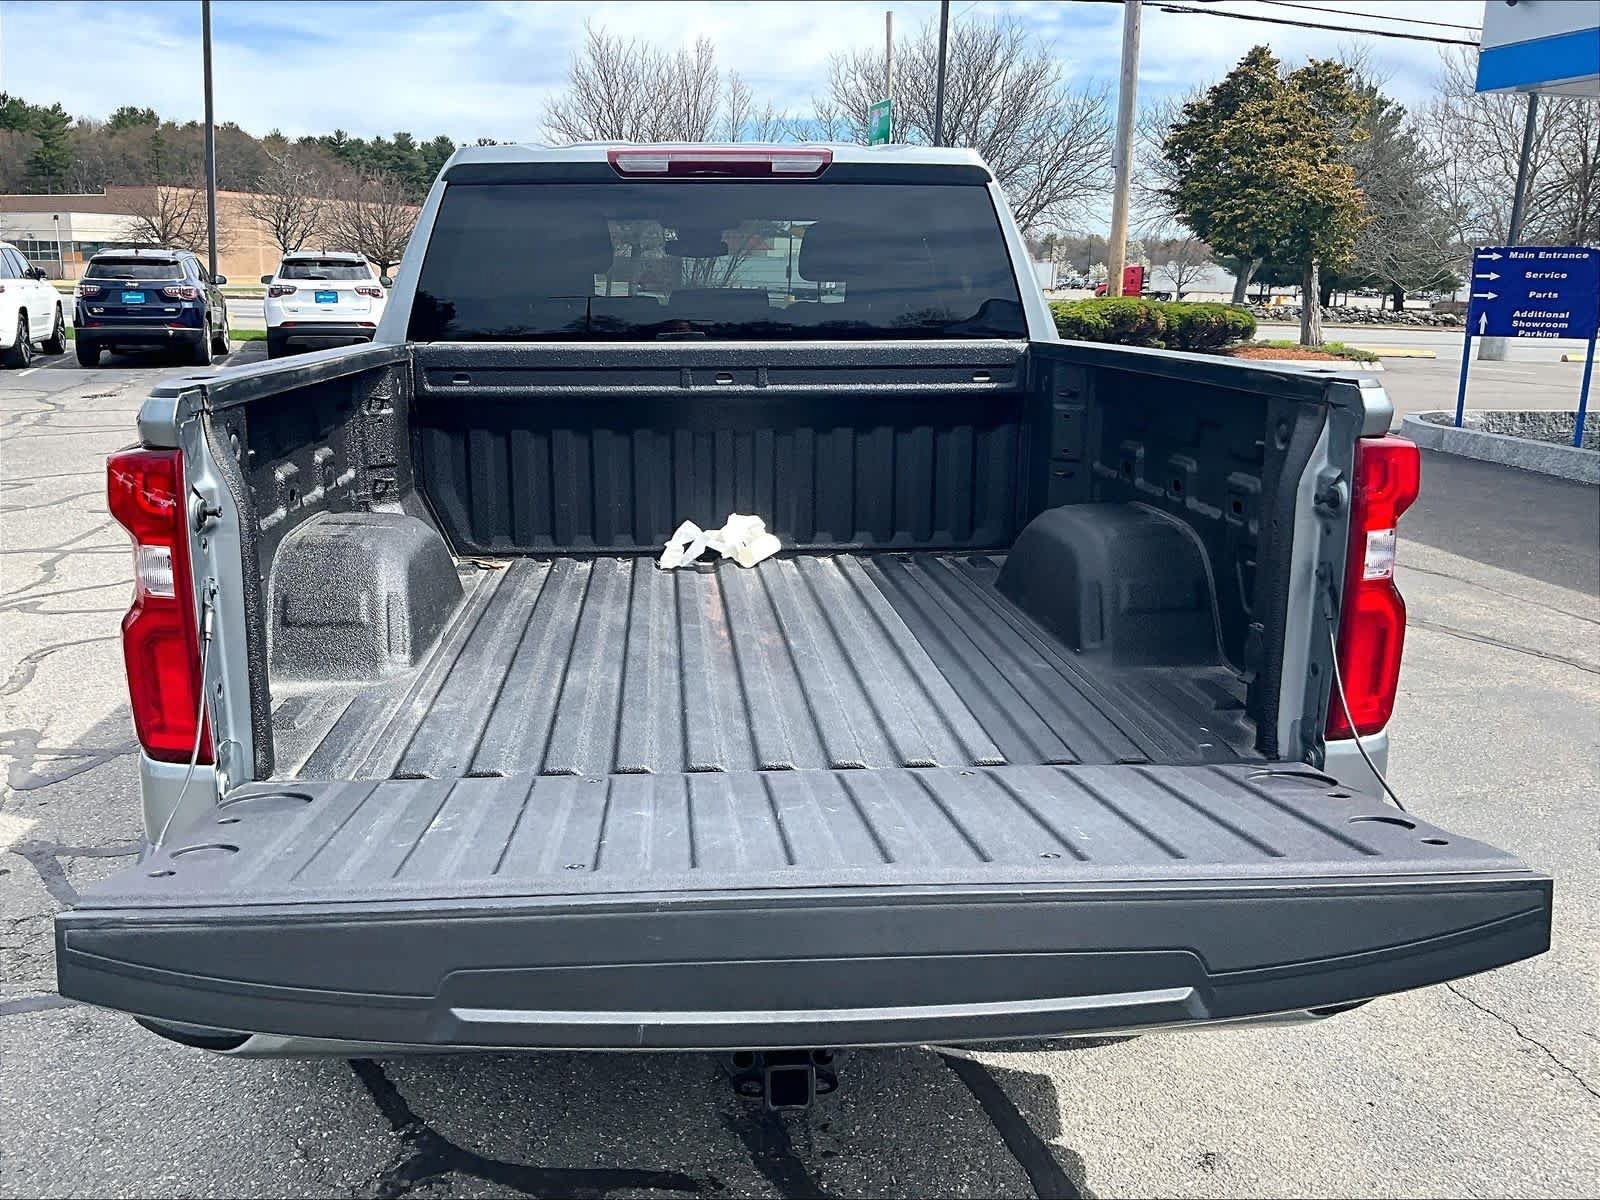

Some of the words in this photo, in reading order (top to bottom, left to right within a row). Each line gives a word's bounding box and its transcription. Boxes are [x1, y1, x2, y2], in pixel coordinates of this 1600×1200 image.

[1508, 251, 1535, 259] Main
[1538, 251, 1590, 259] Entrance
[1524, 271, 1568, 279] Service
[1528, 291, 1559, 299] Parts
[1512, 310, 1570, 318] Additional
[1511, 320, 1569, 328] Showroom
